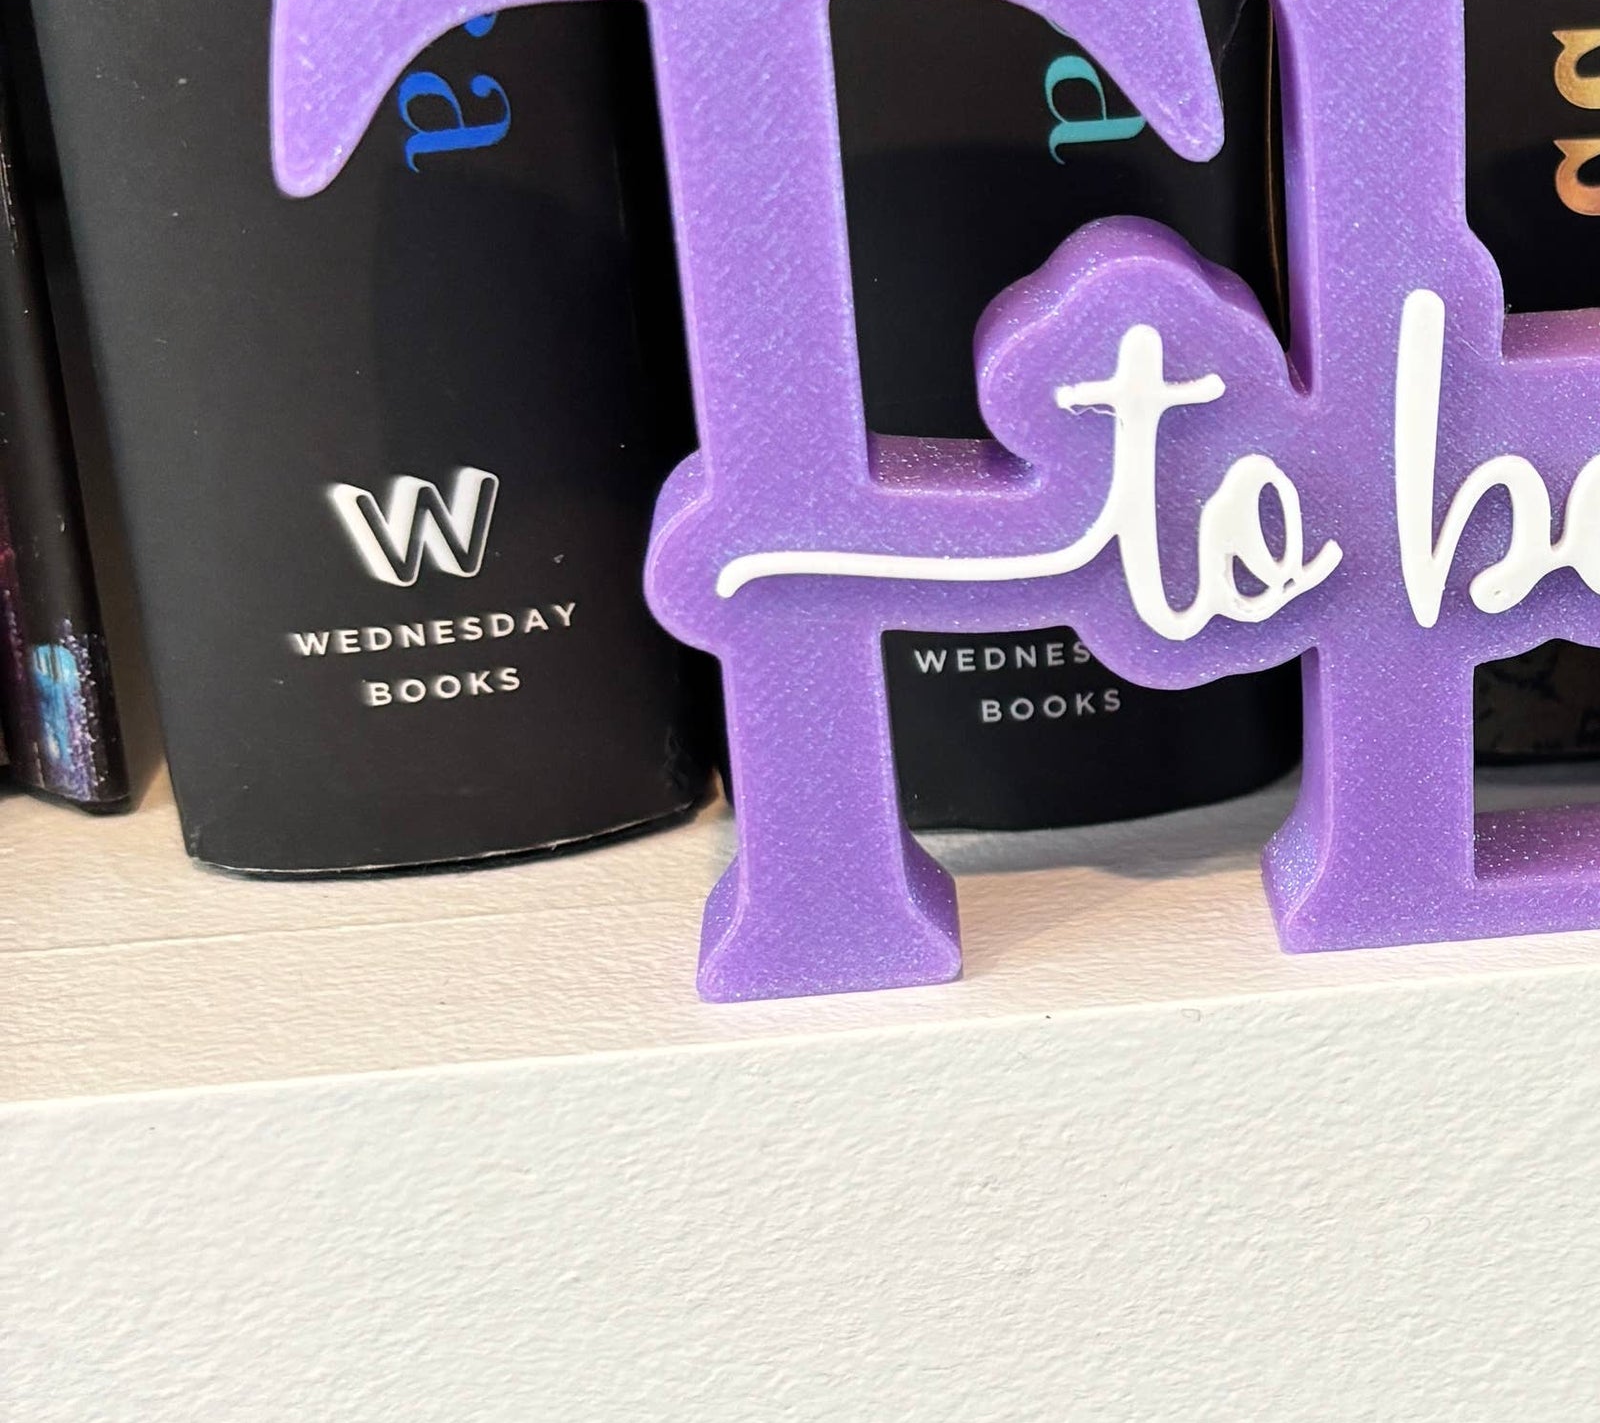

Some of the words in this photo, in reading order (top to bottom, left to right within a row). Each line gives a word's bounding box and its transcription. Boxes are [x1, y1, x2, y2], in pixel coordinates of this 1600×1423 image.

[715, 323, 1343, 640] to
[293, 602, 577, 657] WEDNESDAY
[913, 640, 1092, 674] WEDNES
[365, 666, 521, 707] BOOKS
[981, 688, 1122, 723] BOOKS
